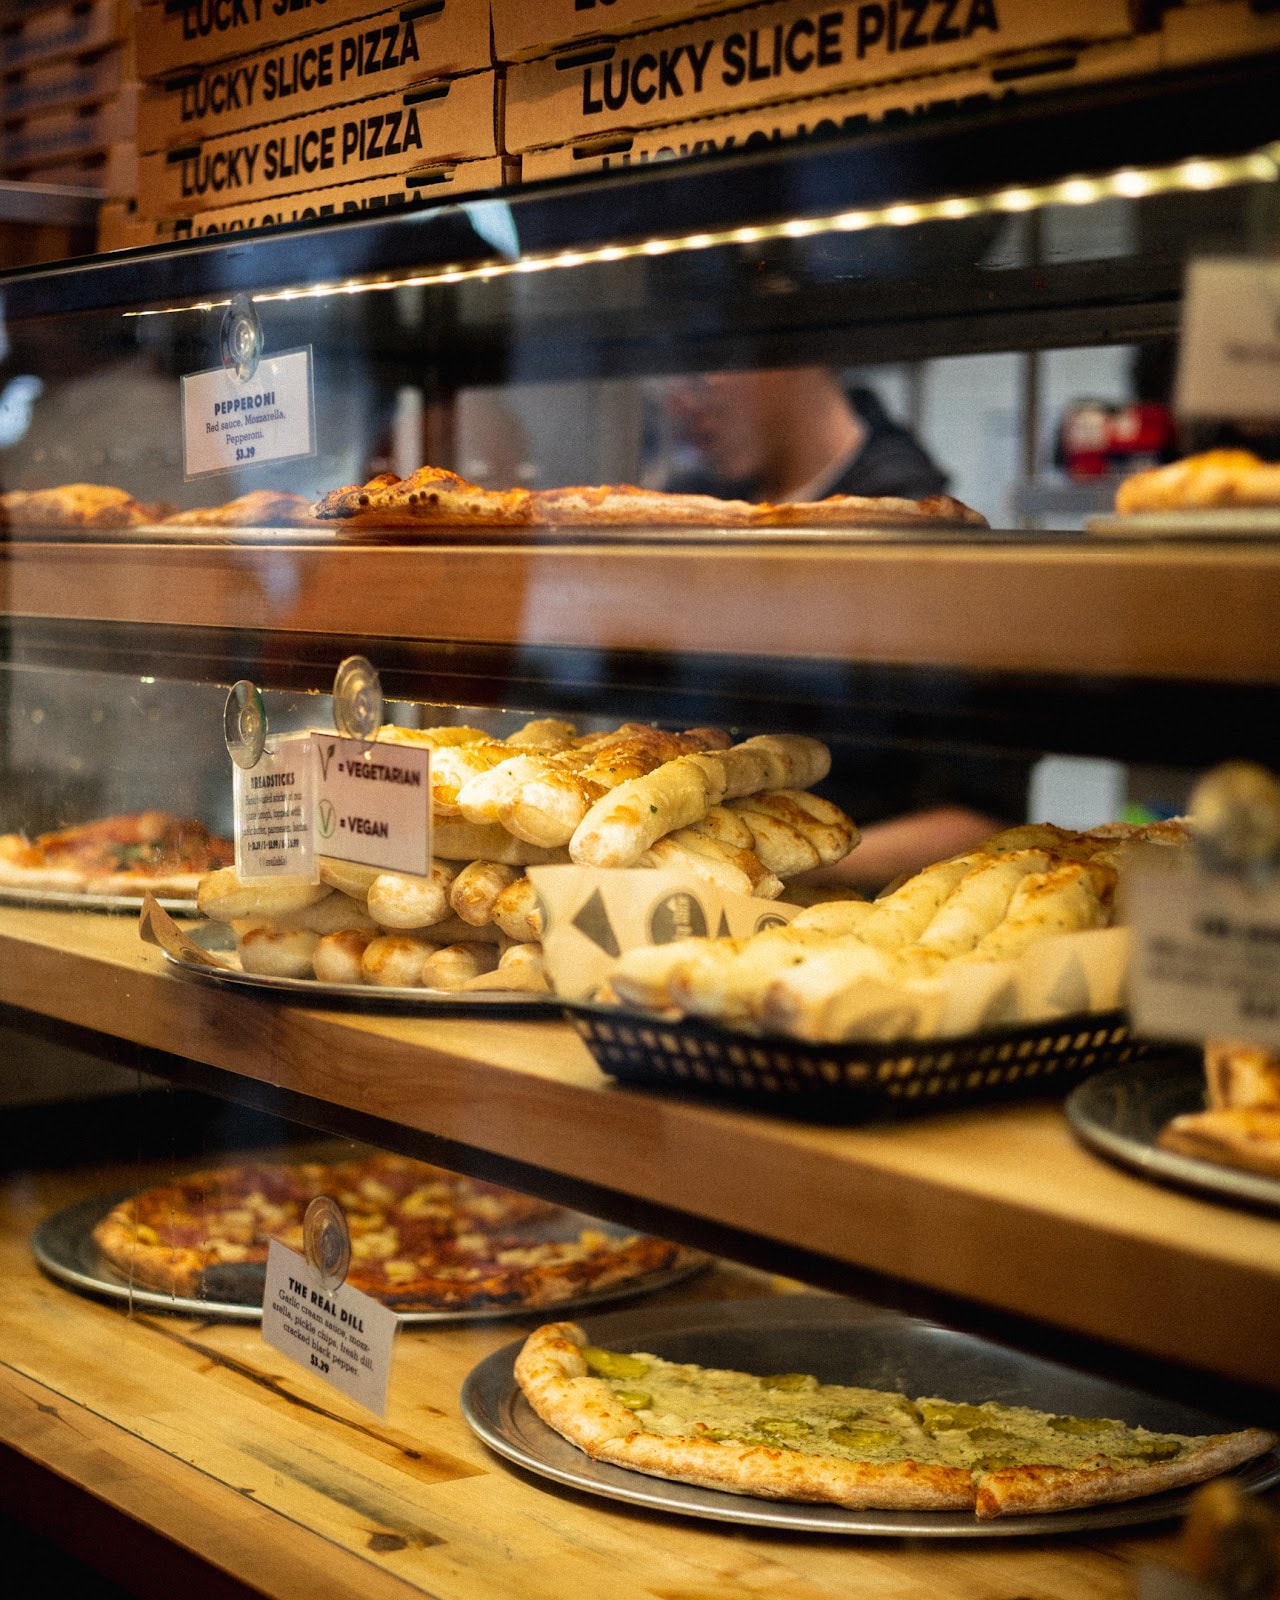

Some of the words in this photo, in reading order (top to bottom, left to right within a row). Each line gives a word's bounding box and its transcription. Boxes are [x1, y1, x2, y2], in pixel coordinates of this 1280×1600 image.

[182, 64, 260, 122] LUCKY
[263, 42, 334, 101] SLICE
[341, 21, 420, 81] PIZZA
[583, 41, 714, 115] LUCKY
[722, 12, 843, 86] SLICE
[857, 0, 999, 59] PIZZA
[182, 143, 260, 197] LUCKY
[264, 126, 336, 181] SLICE
[342, 108, 423, 165] PIZZA
[214, 392, 275, 416] PEPPERONI
[206, 421, 219, 433] Red
[346, 760, 421, 787] VEGETARIAN
[348, 816, 388, 839] VEGAN
[278, 1289, 300, 1310] Garlic
[301, 1305, 324, 1325] cream
[288, 1277, 308, 1299] THE
[311, 1290, 337, 1317] REAL
[340, 1308, 364, 1334] DILL
[283, 1323, 310, 1346] cracked
[311, 1338, 331, 1358] black
[294, 1315, 316, 1335] pickle
[340, 1341, 359, 1361] fresh
[310, 1353, 330, 1374] $3.29
